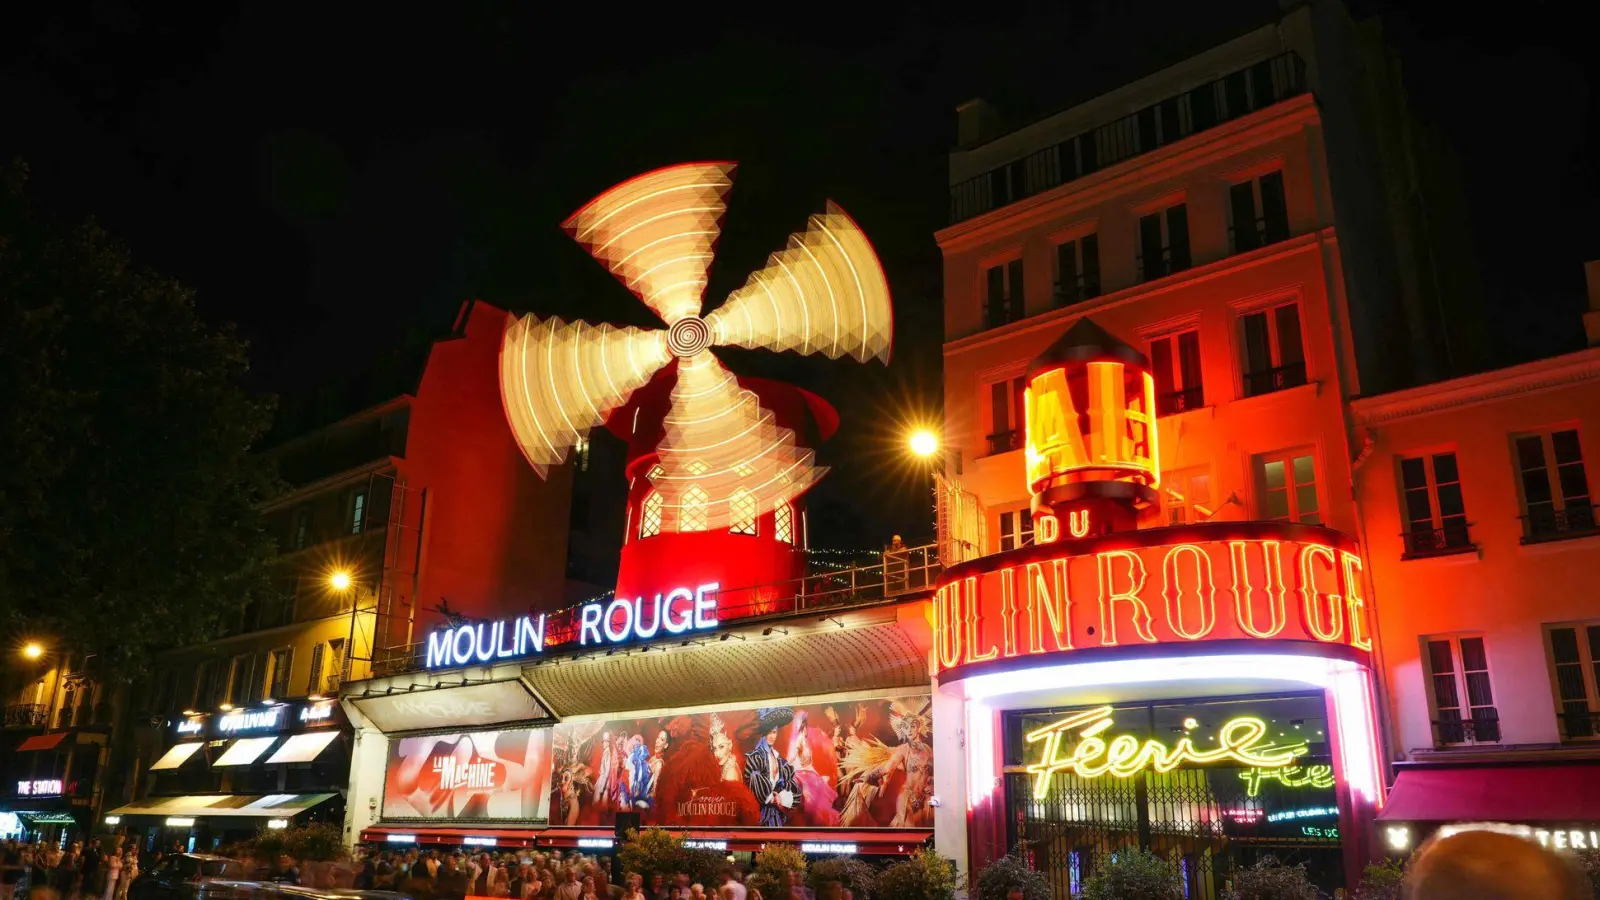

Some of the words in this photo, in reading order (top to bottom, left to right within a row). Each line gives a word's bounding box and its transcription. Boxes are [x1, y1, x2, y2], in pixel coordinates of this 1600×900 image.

[1040, 510, 1089, 542] DU
[426, 613, 545, 668] MOULIN
[580, 582, 719, 646] ROUGE
[932, 558, 1075, 675] ULIN
[1097, 541, 1372, 651] ROUGE
[1026, 704, 1309, 800] Féerie
[17, 780, 31, 795] THE
[32, 779, 63, 795] STATION
[440, 756, 497, 790] MACHINE
[676, 801, 707, 817] MOULIN
[708, 801, 737, 817] ROUGE
